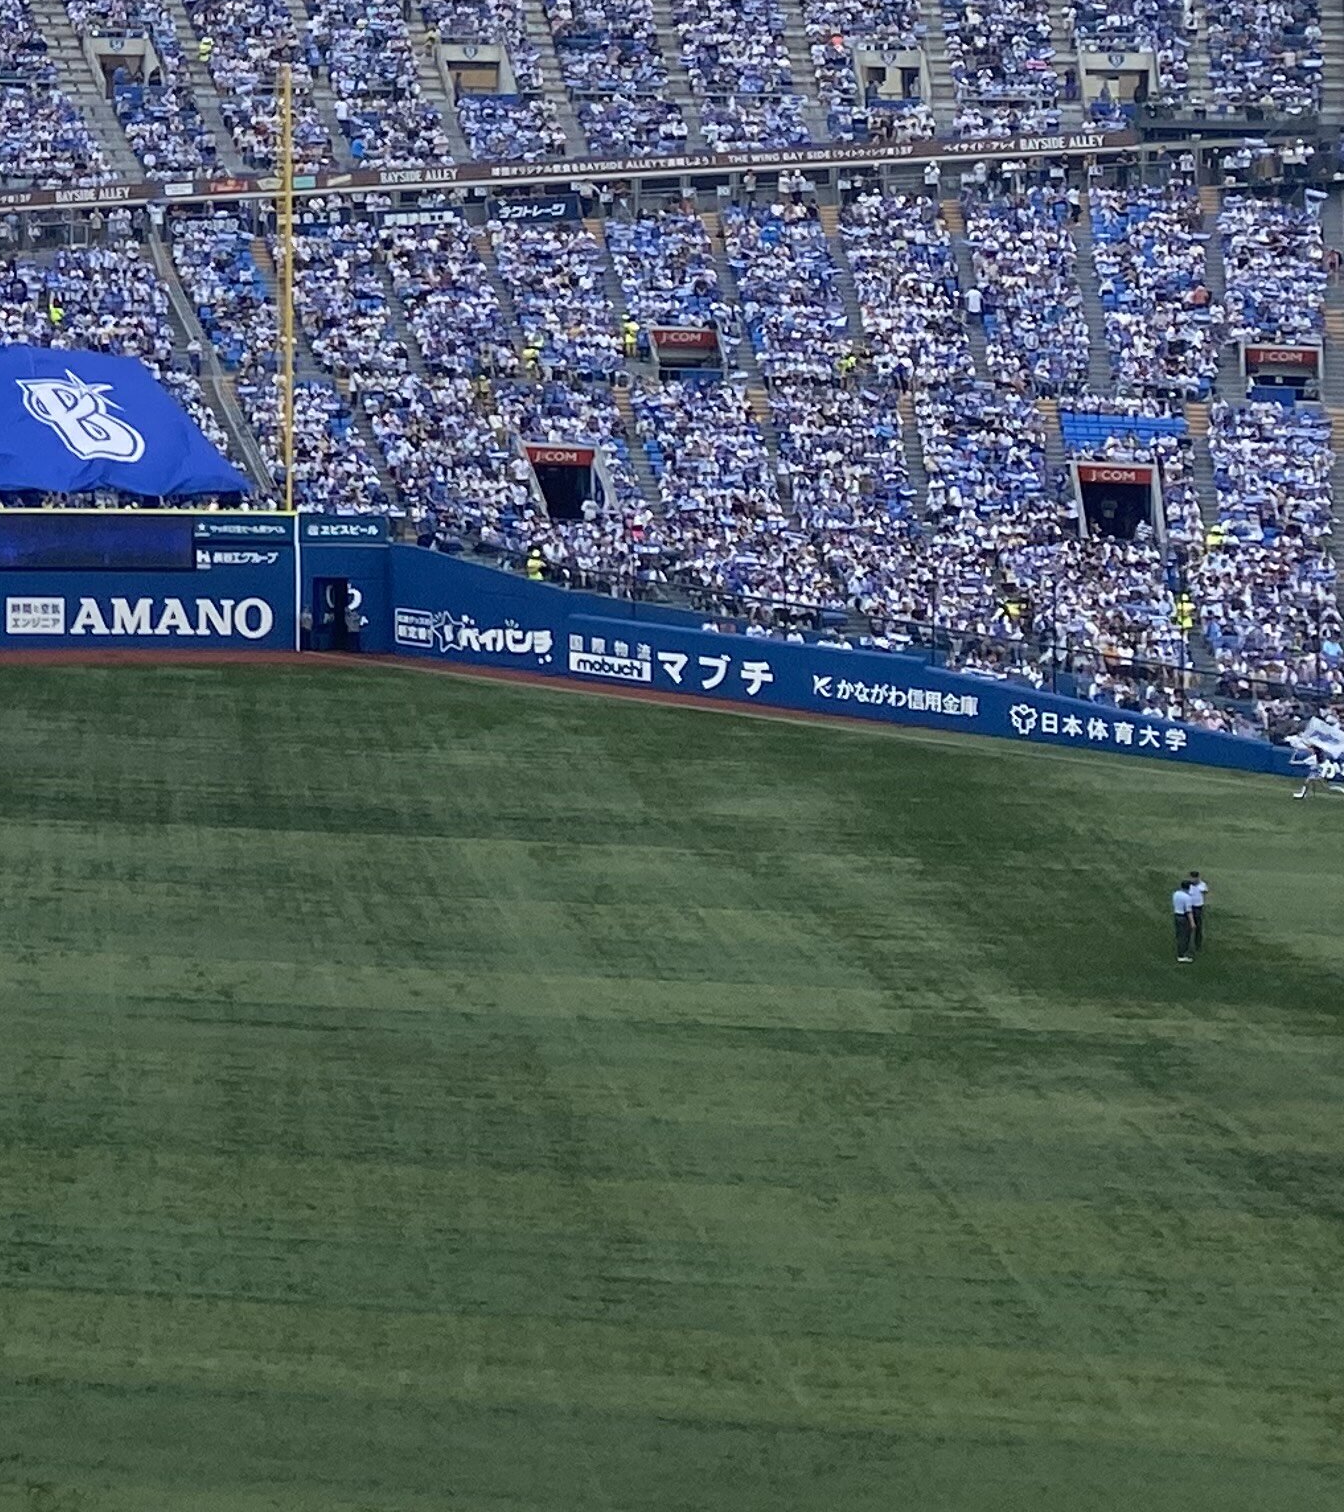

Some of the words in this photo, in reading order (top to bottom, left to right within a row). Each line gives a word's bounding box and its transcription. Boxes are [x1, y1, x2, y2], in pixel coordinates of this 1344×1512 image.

[1020, 137, 1065, 151] BAYSIDE
[1069, 135, 1105, 148] ALLEY
[728, 154, 748, 164] THE
[752, 152, 780, 163] WING
[783, 151, 804, 161] BAY
[806, 149, 831, 160] SIDE
[380, 170, 423, 184] BAYSIDE
[425, 168, 458, 182] ALLEY
[55, 189, 97, 203] BAYSIDE
[98, 187, 131, 201] ALLEY
[11, 617, 61, 629] エンジニア
[70, 596, 274, 640] AMANO
[657, 651, 774, 696] マブチ
[837, 678, 979, 717] かながわ信用金庫
[1041, 711, 1188, 751] 日本体育大学
